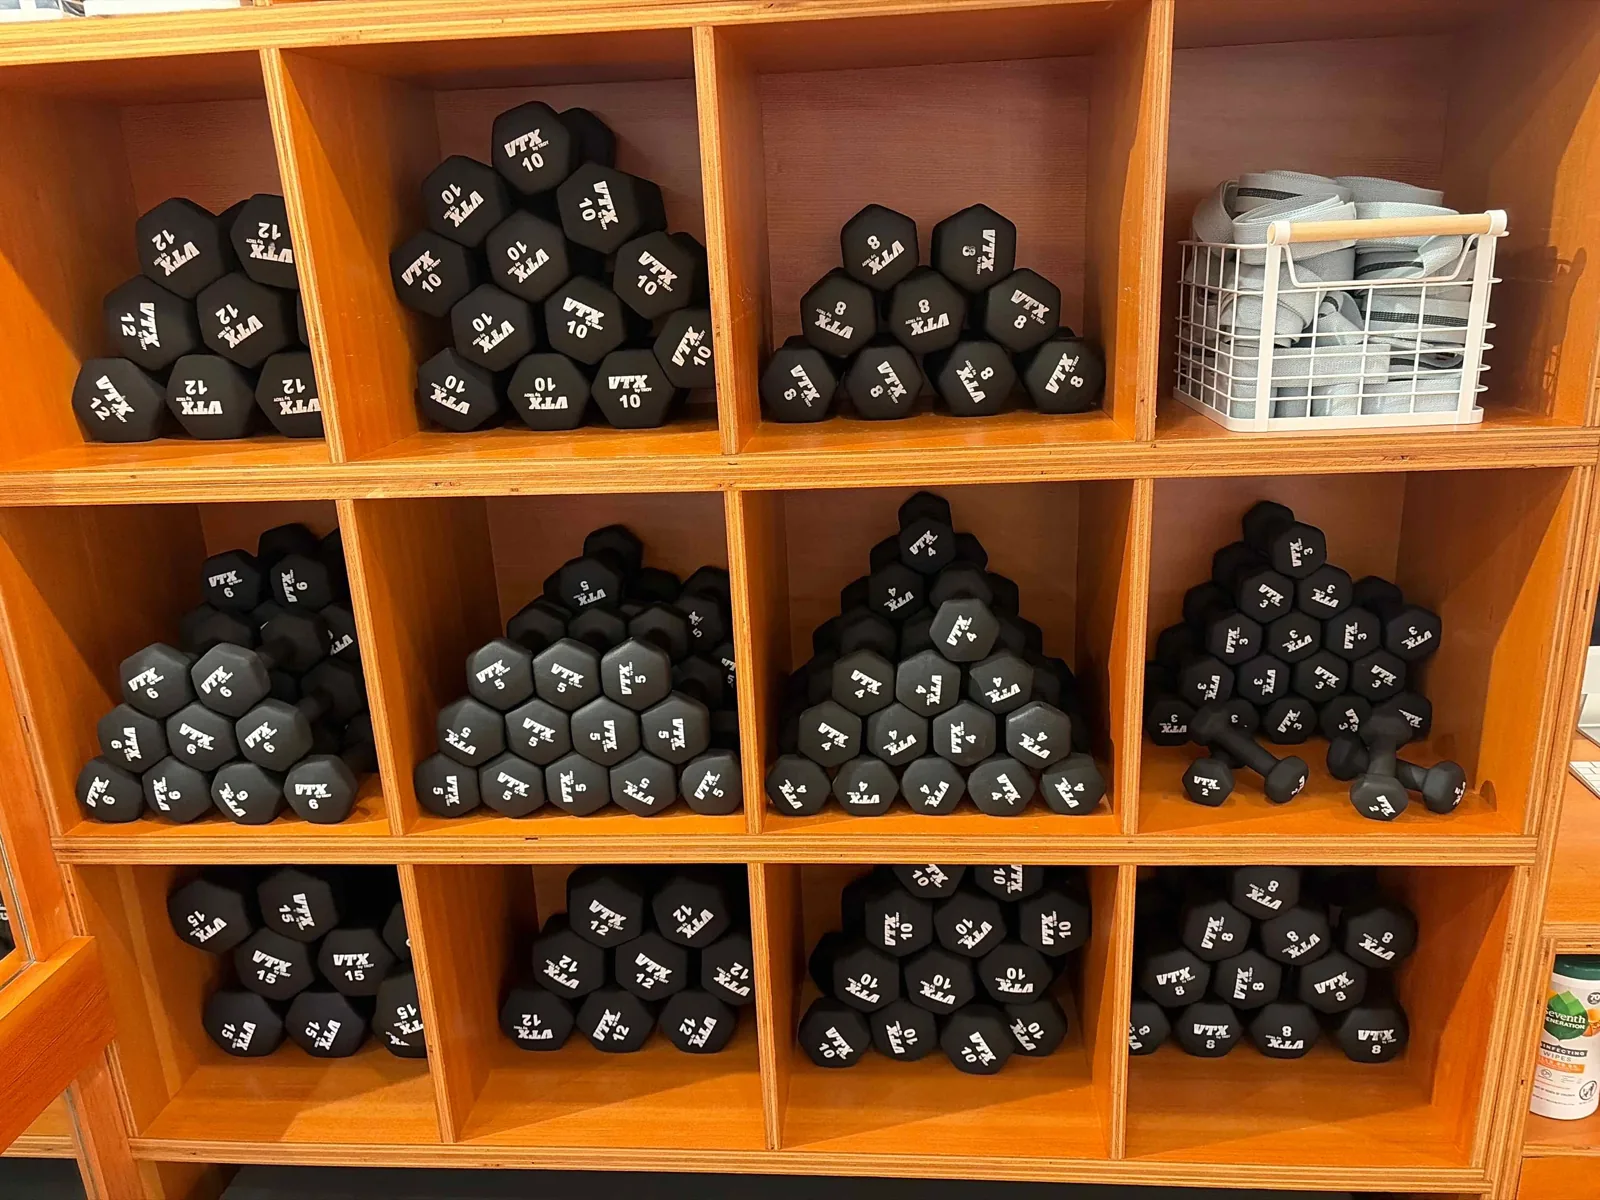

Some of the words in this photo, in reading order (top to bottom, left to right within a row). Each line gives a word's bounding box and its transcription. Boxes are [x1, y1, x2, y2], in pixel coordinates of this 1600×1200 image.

[504, 129, 542, 157] VTX
[523, 153, 543, 171] 10
[442, 184, 460, 204] 10
[594, 181, 618, 224] VTX
[450, 190, 484, 227] VTX
[580, 198, 596, 220] 10
[258, 222, 281, 240] 12
[152, 230, 174, 250] 12
[868, 236, 880, 249] 8
[160, 242, 200, 276] VTX
[250, 244, 293, 263] VTX
[508, 242, 526, 260] 10
[868, 240, 904, 274] VTX
[982, 230, 995, 271] VTX
[402, 251, 434, 286] VTX
[515, 249, 549, 283] VTX
[638, 251, 677, 285] VTX
[422, 274, 441, 292] 10
[638, 276, 657, 295] 10
[563, 297, 604, 325] VTX
[835, 302, 846, 315] 8
[919, 300, 929, 313] 8
[1011, 290, 1049, 318] VTX
[216, 304, 238, 324] 12
[473, 313, 492, 331] 10
[1014, 315, 1026, 328] 8
[121, 313, 136, 336] 12
[140, 303, 160, 348] VTX
[224, 316, 263, 348] VTX
[568, 321, 587, 338] 10
[815, 313, 853, 338] VTX
[911, 313, 949, 335] VTX
[478, 320, 514, 353] VTX
[672, 327, 700, 366] VTX
[694, 346, 711, 365] 10
[877, 361, 906, 397] VTX
[981, 367, 993, 379] 8
[1046, 353, 1074, 393] VTX
[1071, 376, 1083, 387] 8
[185, 381, 207, 394] 12
[282, 379, 305, 394] 12
[446, 376, 465, 393] 10
[535, 378, 555, 391] 10
[609, 375, 648, 390] VTX
[790, 365, 820, 400] VTX
[871, 385, 883, 397] 8
[956, 366, 985, 402] VTX
[95, 376, 134, 417] VTX
[431, 389, 470, 414] VTX
[529, 397, 568, 409] VTX
[620, 394, 640, 408] 10
[784, 389, 796, 400] 8
[91, 398, 110, 420] 12
[181, 401, 222, 414] VTX
[280, 398, 321, 414] VTX
[910, 531, 934, 555] VTX
[928, 548, 936, 556] 4
[1290, 541, 1302, 566] VTX
[209, 571, 237, 587] VTX
[581, 581, 589, 590] 5
[224, 588, 233, 597] 6
[578, 589, 606, 606] VTX
[1327, 585, 1335, 593] 3
[1312, 591, 1338, 607] VTX
[1344, 624, 1355, 648] VTX
[128, 668, 158, 691] VTX
[476, 660, 505, 683] VTX
[619, 664, 632, 694] VTX
[1315, 666, 1339, 685] VTX
[494, 679, 504, 689] 5
[851, 670, 882, 693] VTX
[916, 685, 926, 693] 4
[931, 675, 941, 704] VTX
[147, 688, 158, 698] 6
[855, 690, 864, 698] 4
[124, 727, 141, 759] VTX
[180, 723, 214, 748] VTX
[603, 720, 617, 750] VTX
[951, 723, 962, 753] VTX
[966, 735, 976, 743] 4
[111, 740, 122, 748] 6
[187, 744, 196, 754] 6
[295, 784, 328, 796] VTX
[694, 771, 714, 799] VTX
[859, 782, 868, 791] 4
[1194, 776, 1217, 789] VTX
[713, 788, 723, 797] 5
[849, 793, 879, 804] VTX
[309, 799, 318, 809] 6
[1268, 881, 1278, 892] 8
[1246, 890, 1282, 909] VTX
[280, 905, 294, 922] 15
[293, 894, 314, 927] VTX
[589, 900, 626, 926] VTX
[673, 906, 692, 922] 12
[188, 911, 204, 928] 15
[591, 921, 608, 935] 12
[682, 909, 713, 938] VTX
[956, 919, 972, 934] 10
[197, 918, 226, 942] VTX
[885, 914, 897, 945] VTX
[901, 924, 912, 940] 10
[966, 921, 992, 949] VTX
[1042, 914, 1054, 944] VTX
[1059, 922, 1071, 938] 10
[1202, 917, 1220, 948] VTX
[1222, 933, 1233, 941] 8
[253, 950, 291, 974] VTX
[334, 953, 370, 966] VTX
[636, 953, 672, 978] VTX
[257, 970, 276, 983] 15
[345, 970, 364, 980] 15
[637, 974, 654, 988] 12
[934, 975, 951, 989] 10
[1007, 968, 1025, 979] 10
[1157, 967, 1192, 984] VTX
[998, 981, 1033, 992] VTX
[1175, 986, 1184, 995] 8
[1314, 972, 1350, 993] VTX
[920, 987, 955, 1004] VTX
[1336, 992, 1346, 1001] 8
[522, 1014, 541, 1026] 12
[592, 1009, 616, 1042] VTX
[306, 1022, 320, 1038] 15
[319, 1020, 340, 1050] VTX
[518, 1029, 553, 1039] VTX
[613, 1023, 630, 1040] 12
[1194, 1024, 1228, 1036] VTX
[1358, 1030, 1394, 1042] VTX
[968, 1032, 996, 1063] VTX
[1206, 1040, 1214, 1048] 8
[1372, 1045, 1381, 1054] 8
[962, 1047, 976, 1062] 10
[1542, 1050, 1572, 1062] WIPES
